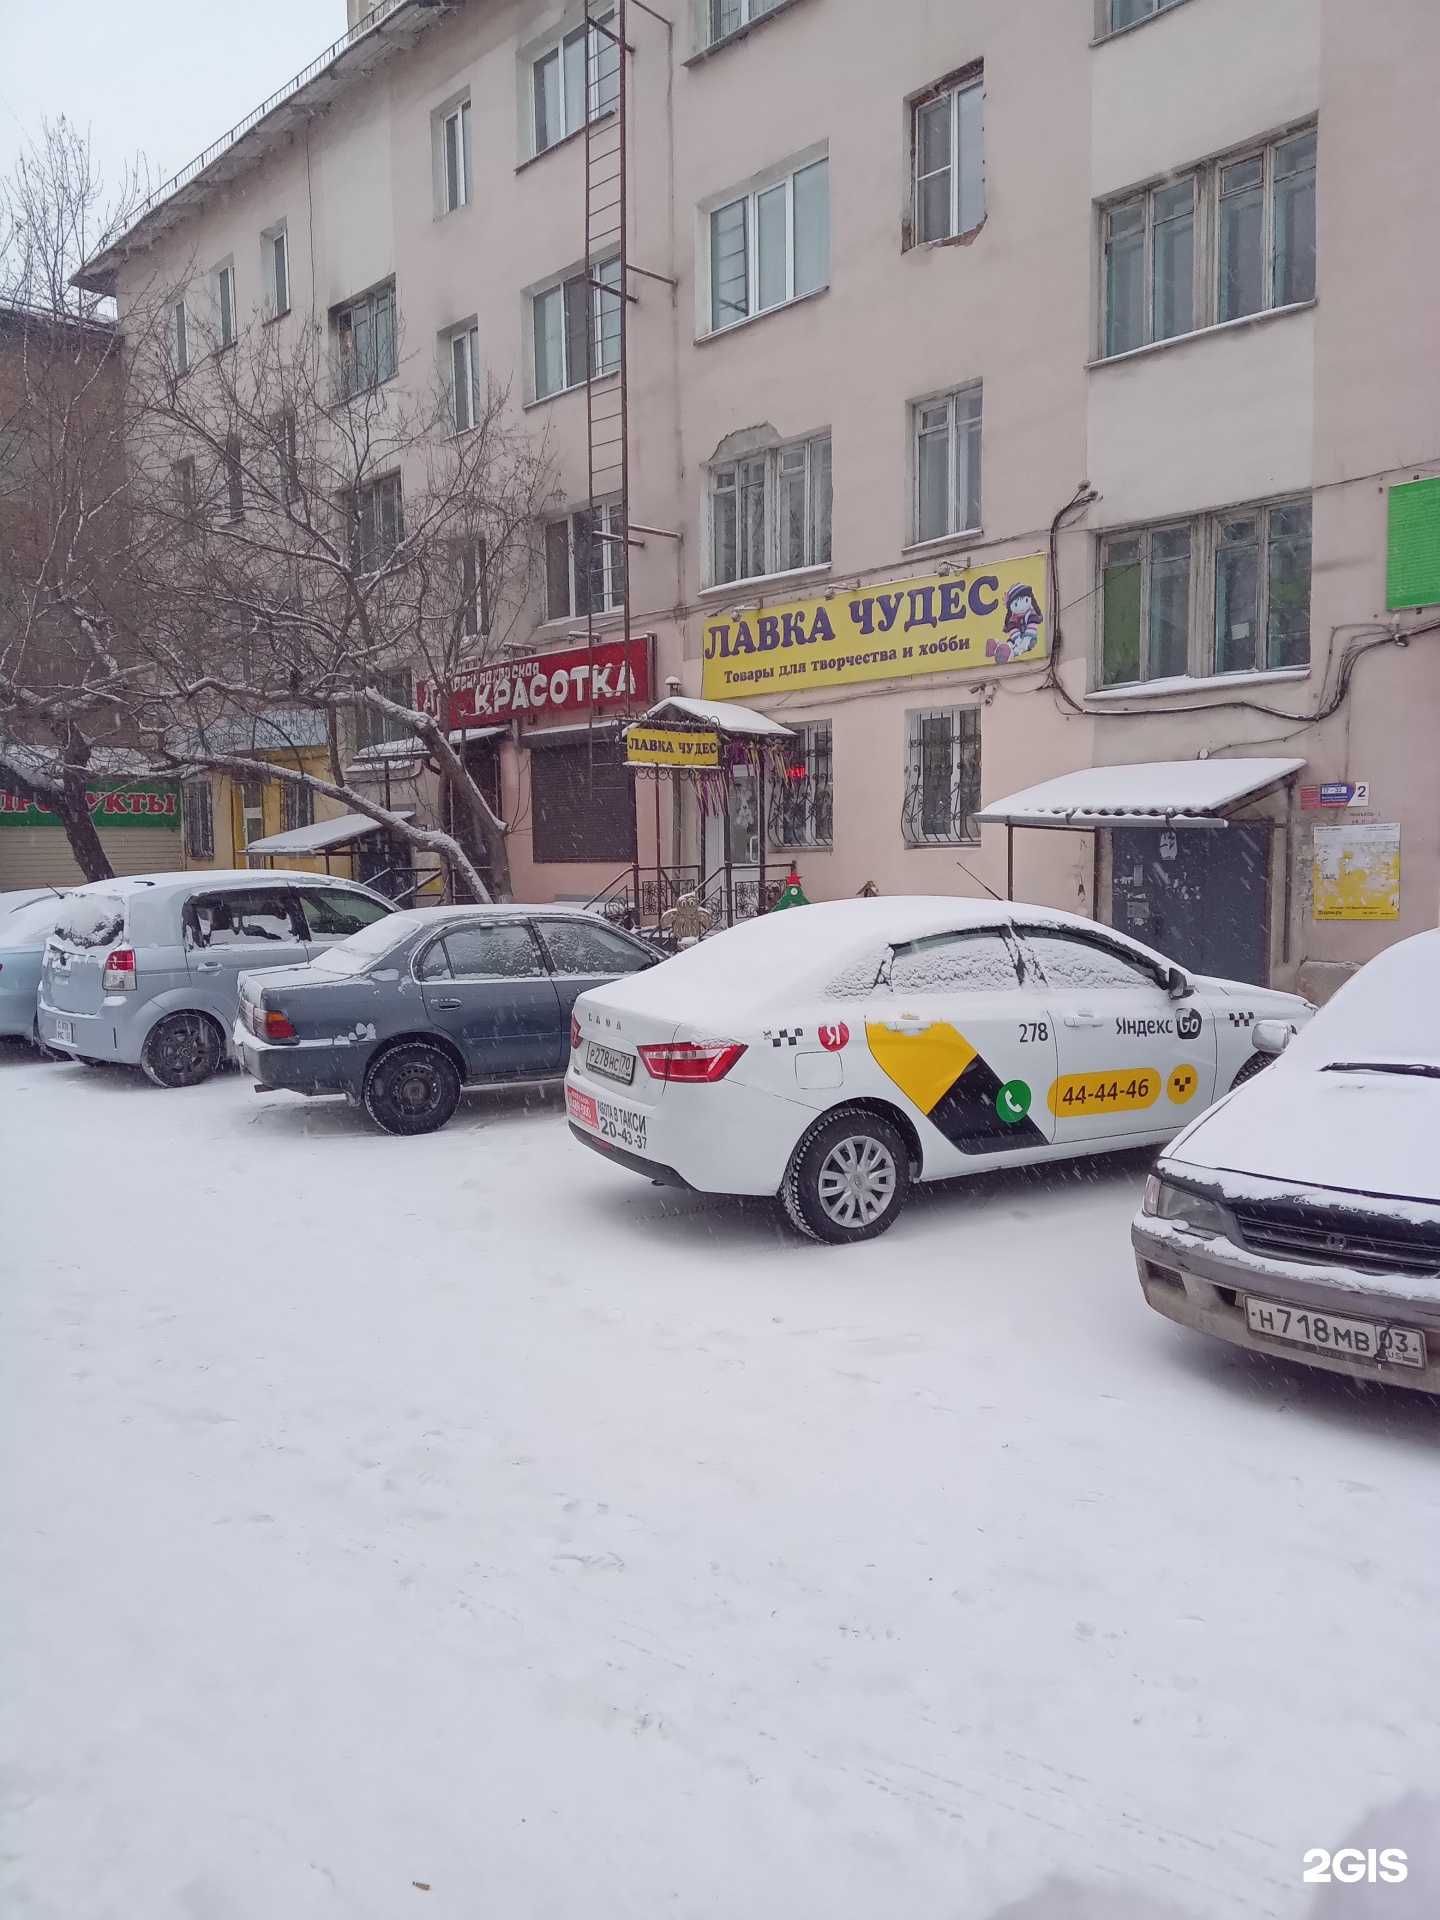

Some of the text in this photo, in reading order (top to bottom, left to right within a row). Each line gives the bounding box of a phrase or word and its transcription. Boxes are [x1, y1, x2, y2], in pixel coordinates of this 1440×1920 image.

[705, 575, 1000, 659] ЛАВКА ЧУДЕС
[724, 635, 971, 685] Товары для творчества и хобби
[474, 661, 636, 715] КРАСОТКА
[629, 737, 717, 757] ЛАВКА ЧУДЕС
[1358, 785, 1366, 798] 2
[1019, 1023, 1048, 1042] 278
[1116, 1017, 1173, 1037] Яндекс
[590, 1047, 620, 1071] Р278НС
[1063, 1078, 1149, 1106] 44-44-46
[600, 1116, 647, 1150] 20-43-37
[618, 1108, 647, 1136] ТАКСИ
[1260, 1308, 1370, 1351] Н718МВ
